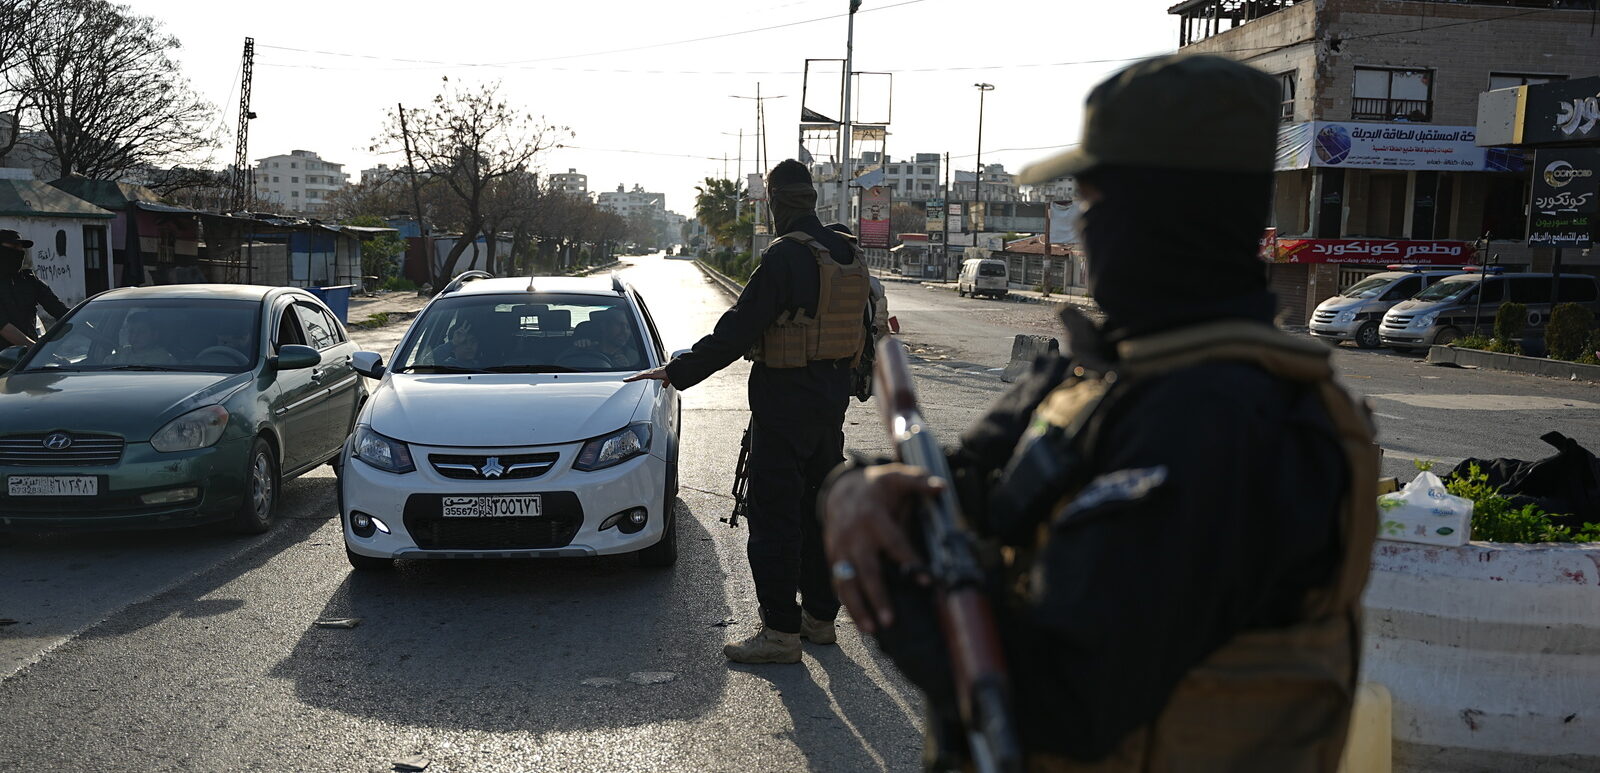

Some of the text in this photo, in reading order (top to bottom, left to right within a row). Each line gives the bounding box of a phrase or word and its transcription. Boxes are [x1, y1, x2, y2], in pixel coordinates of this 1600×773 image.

[1556, 92, 1600, 135] ورد
[1351, 127, 1382, 142] البديلة
[1382, 128, 1415, 140] للطاقة
[1415, 130, 1459, 143] المستقبل
[1535, 191, 1594, 209] كونكورد
[1575, 231, 1590, 245] نعم
[1311, 241, 1462, 259] مطعم كونكورد
[445, 507, 479, 516] 355676
[491, 498, 539, 516] ٣٥٥٦٧٦
